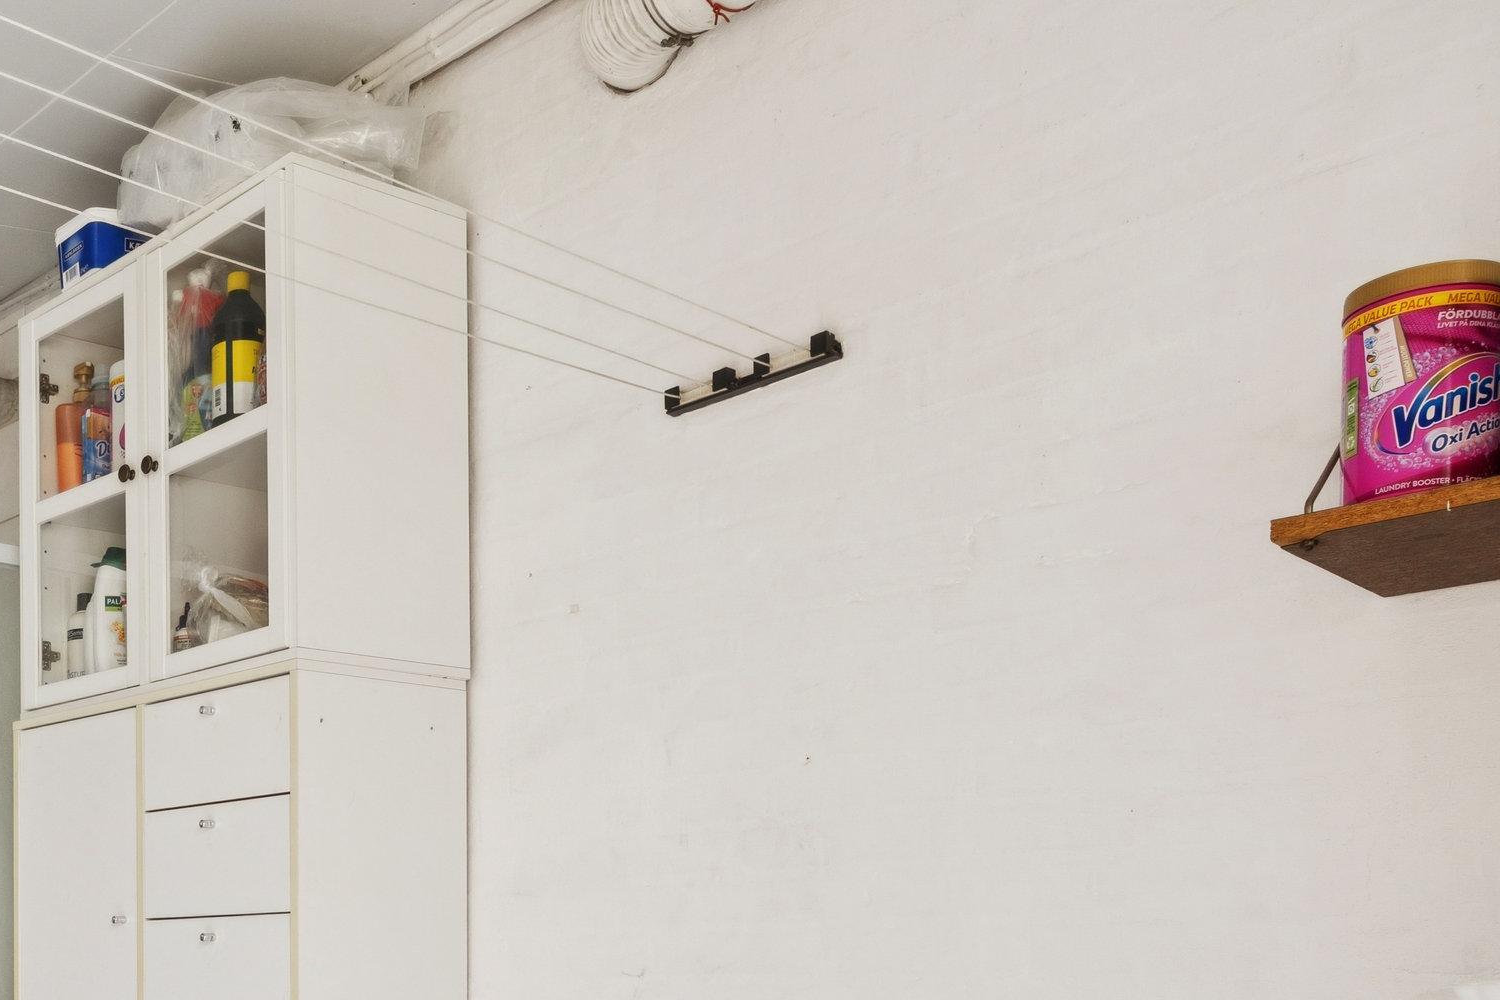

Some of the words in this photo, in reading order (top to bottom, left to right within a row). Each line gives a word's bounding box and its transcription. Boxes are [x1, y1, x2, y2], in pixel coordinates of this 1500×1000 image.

[1447, 292, 1481, 304] MEGA
[1363, 304, 1397, 323] VALUE
[1400, 296, 1434, 311] PACK
[1431, 428, 1463, 452] Oxi
[1375, 482, 1411, 495] LAUNDRY
[1412, 477, 1451, 487] BOOSTER
